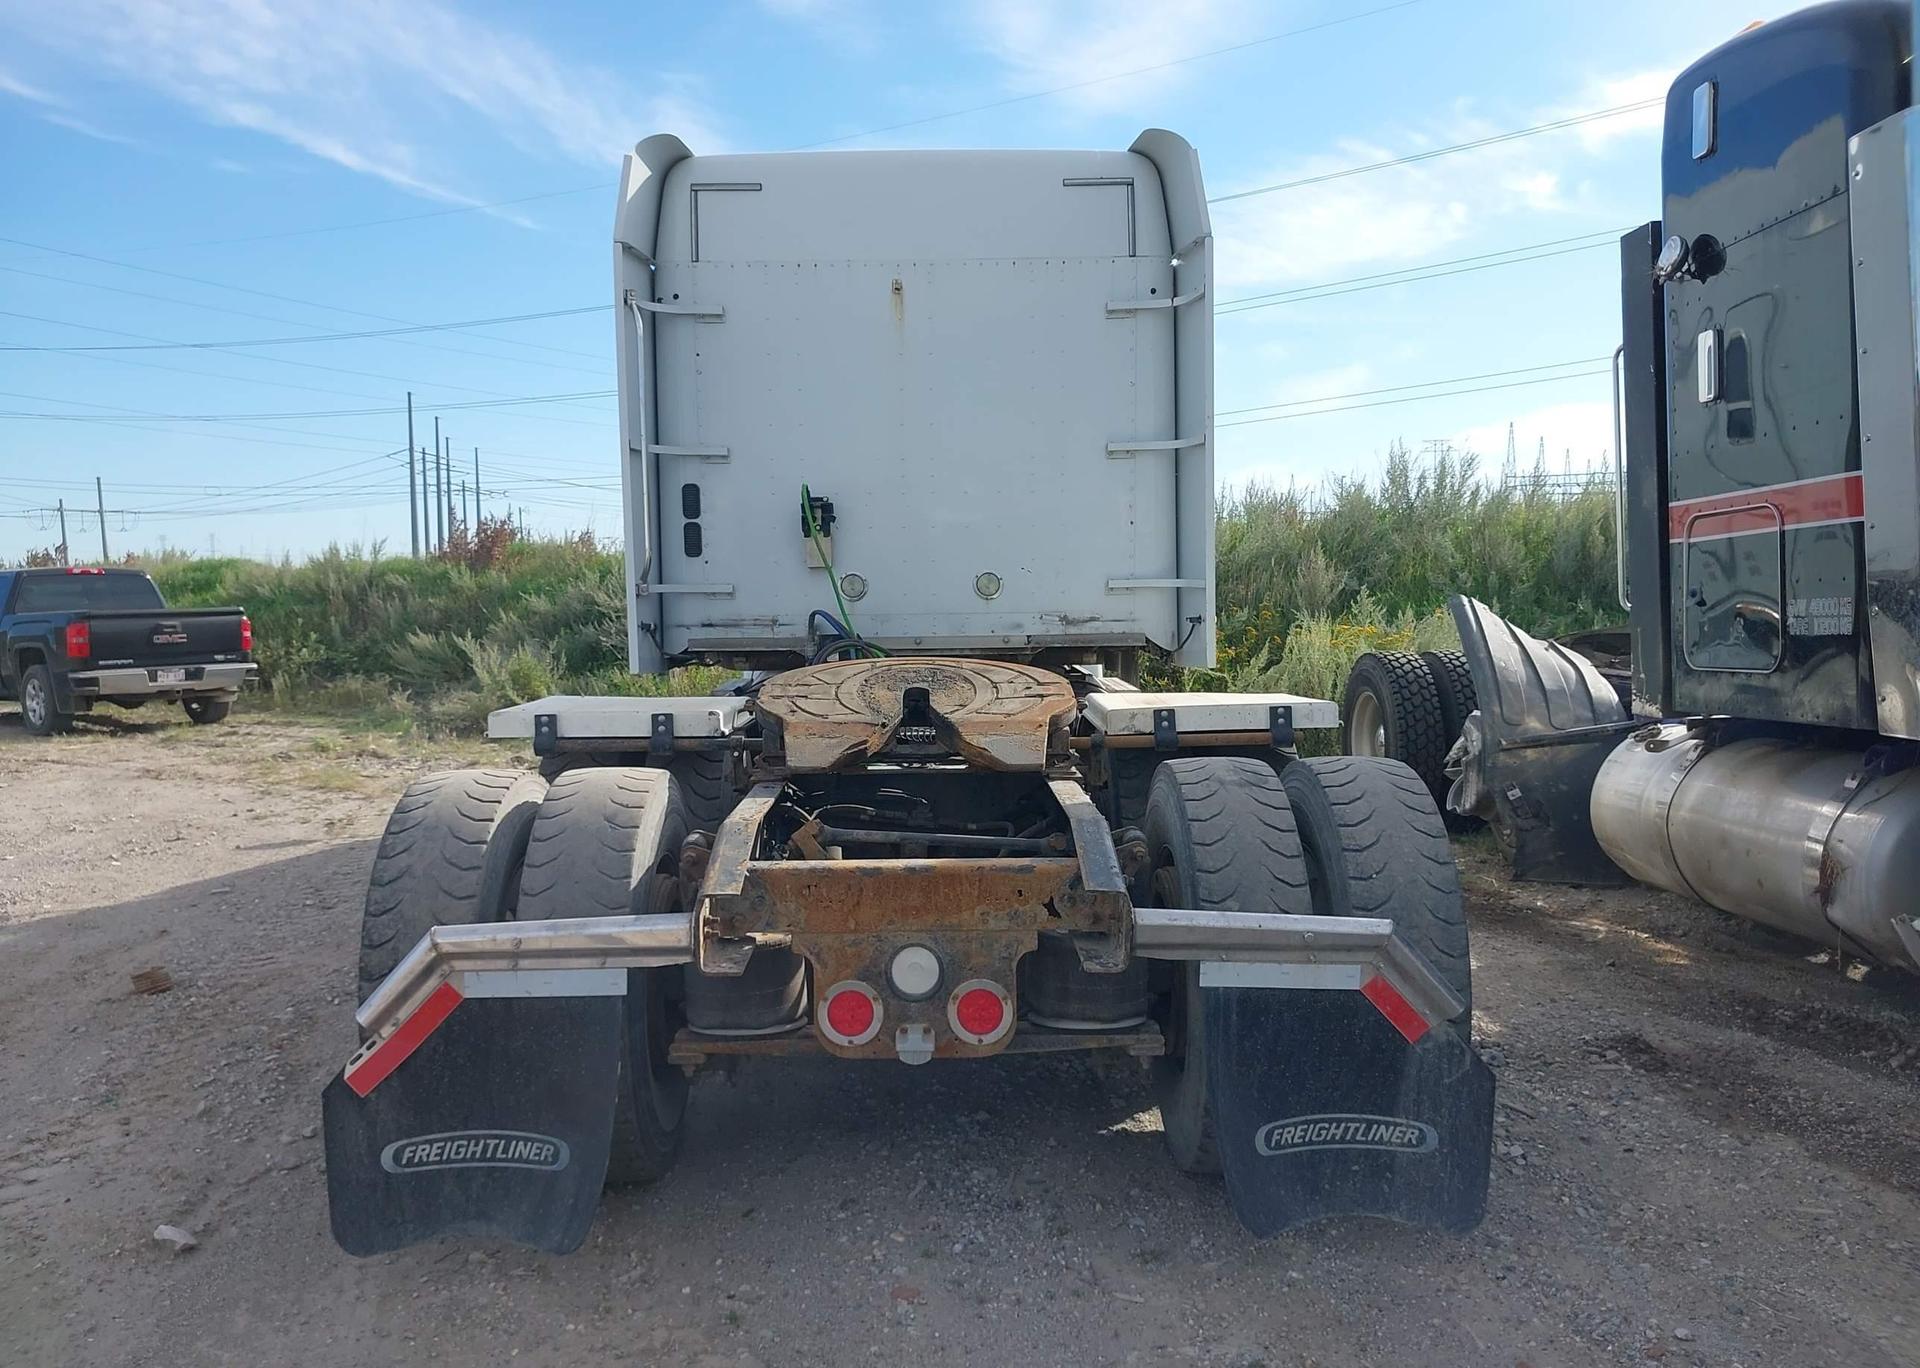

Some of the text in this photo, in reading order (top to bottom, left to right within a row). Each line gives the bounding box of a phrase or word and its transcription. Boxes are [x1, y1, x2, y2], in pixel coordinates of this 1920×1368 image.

[153, 633, 188, 644] GMC
[1270, 1122, 1420, 1147] FREIGHTLINER
[401, 1139, 555, 1165] FREIGHTLINER
